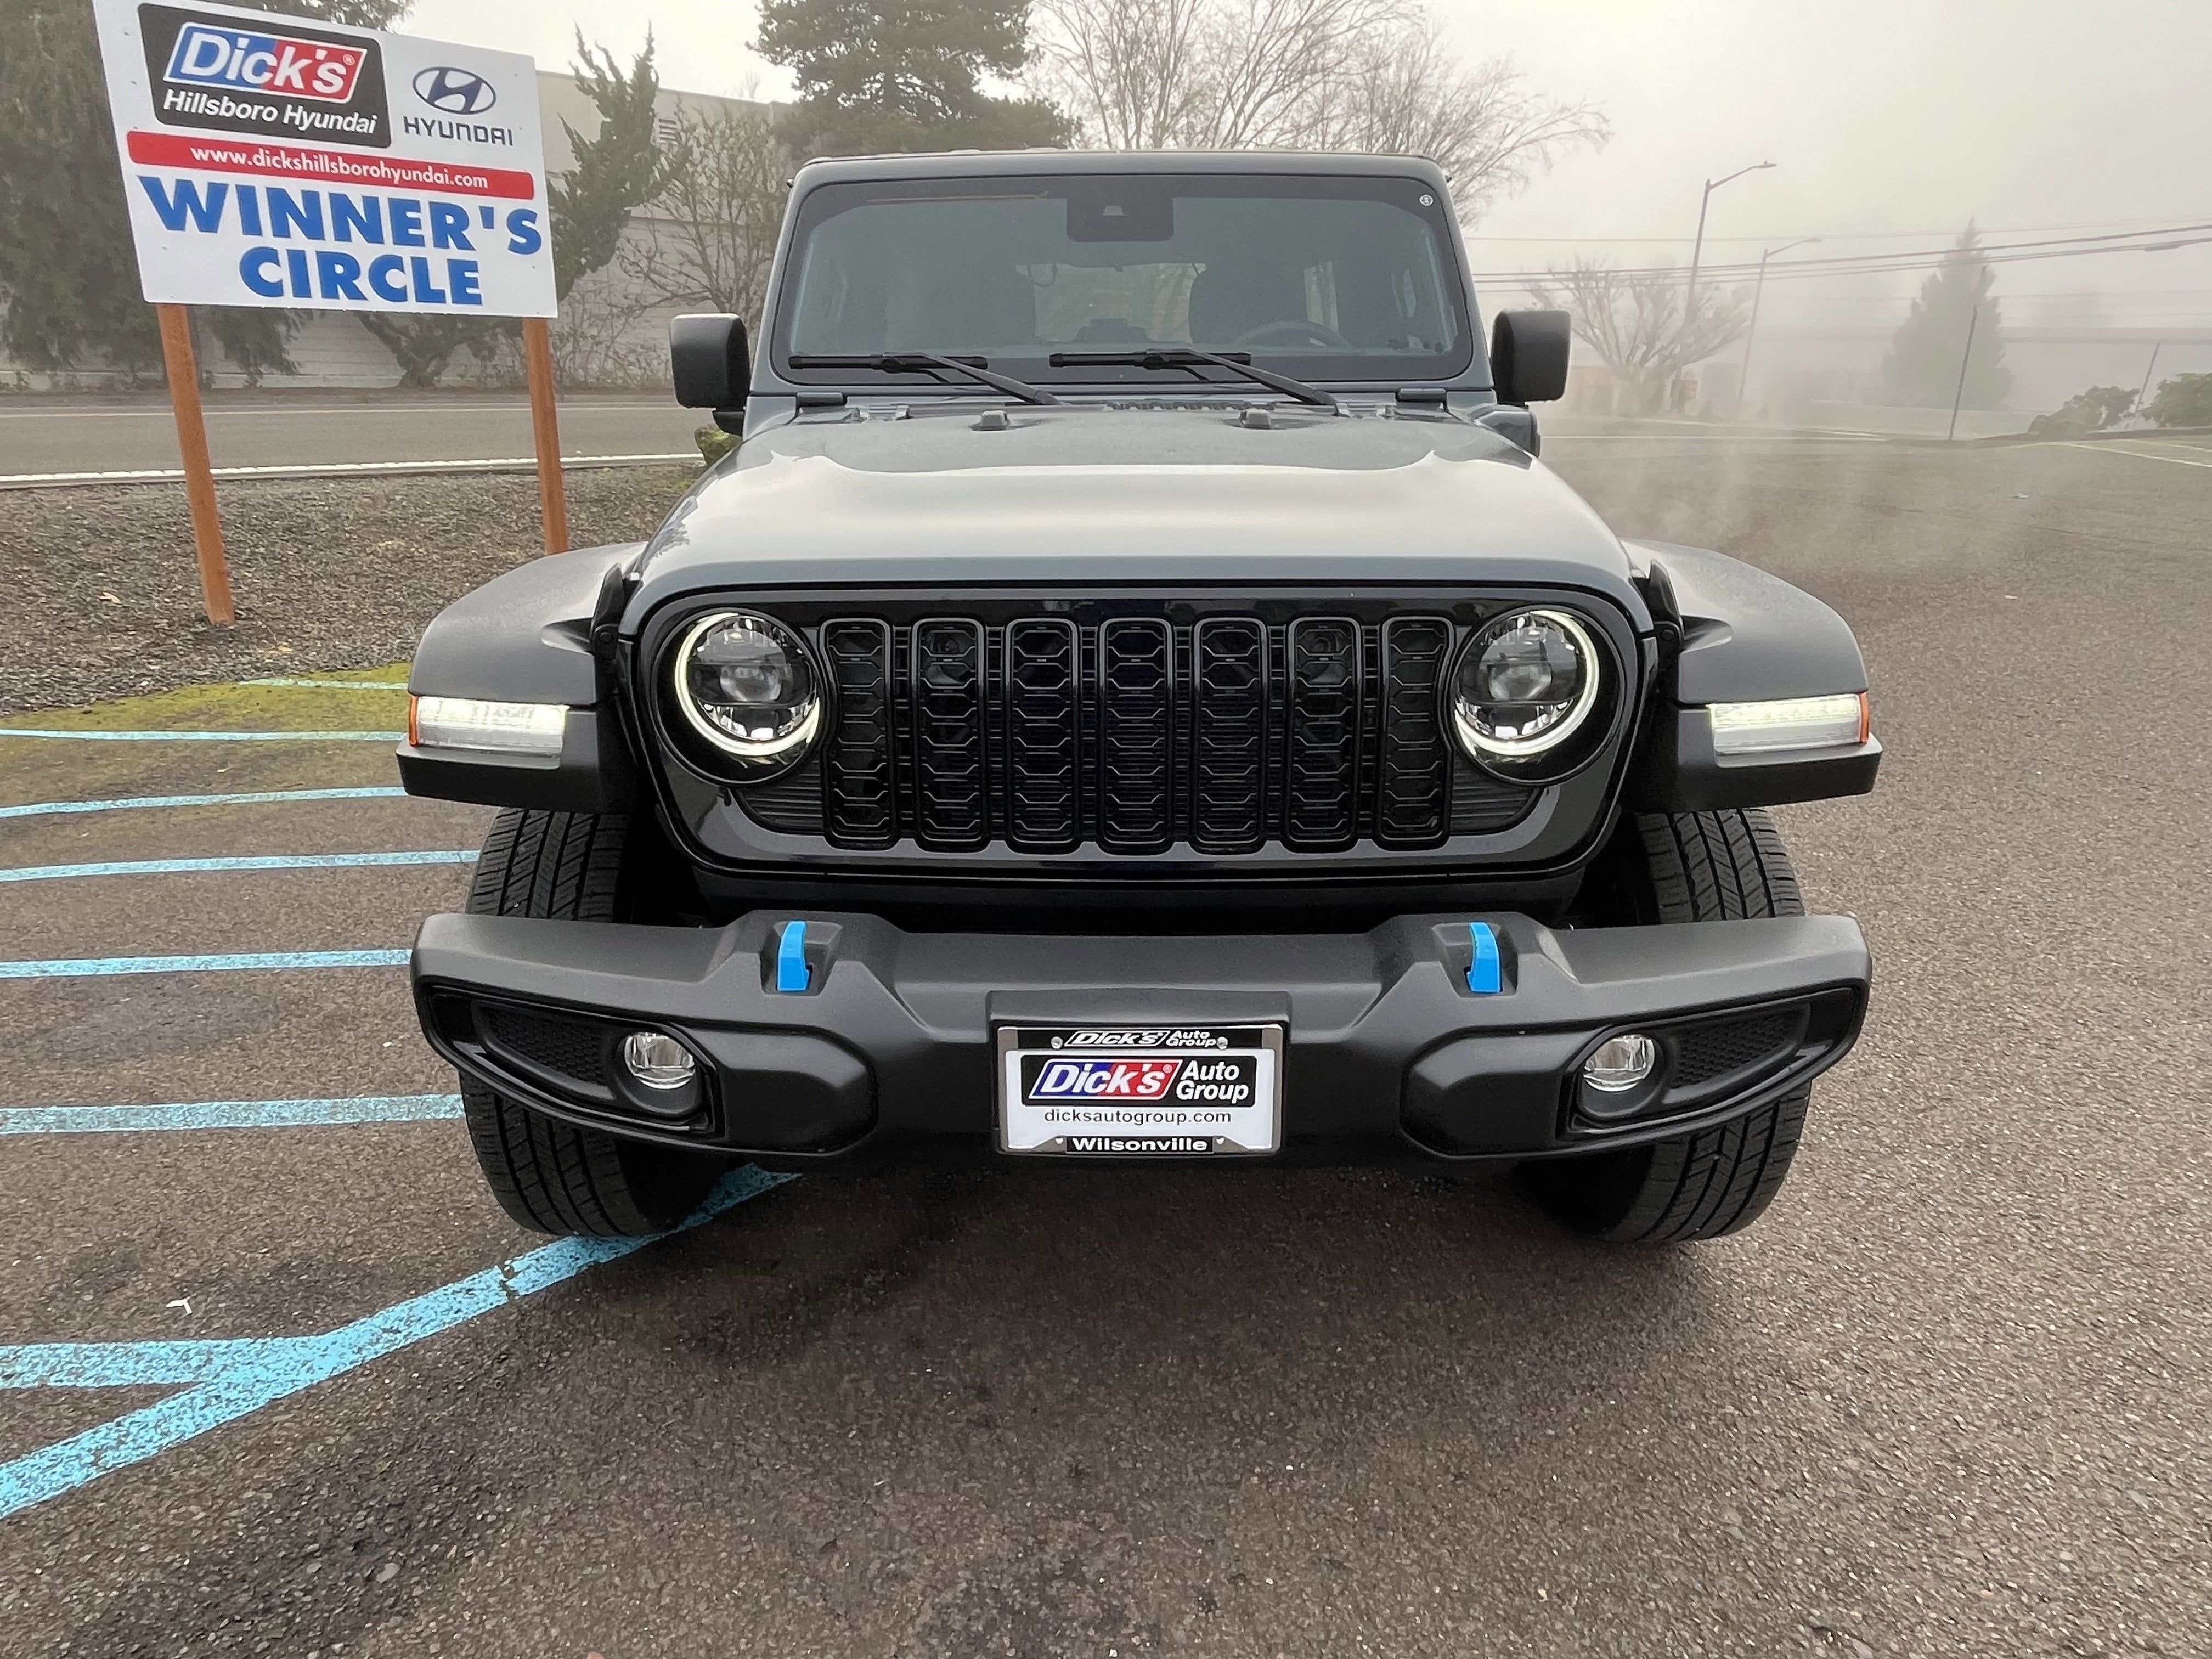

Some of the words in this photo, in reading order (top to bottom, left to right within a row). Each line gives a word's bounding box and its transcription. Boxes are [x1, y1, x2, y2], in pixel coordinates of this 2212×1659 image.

[163, 89, 278, 122] Hillsboro
[283, 105, 377, 134] Hyundai
[403, 115, 513, 146] HYUNDAI
[190, 144, 488, 190] www.dickshillsborohyundai.com
[137, 175, 543, 256] WINNER'S
[239, 247, 483, 306] CIRCLE
[1172, 1030, 1210, 1039] Auto
[1181, 1061, 1240, 1081] Auto
[1176, 1082, 1249, 1104] Group
[1044, 1108, 1232, 1126] dicksautogroup.com
[1072, 1137, 1208, 1152] Wilsonville
